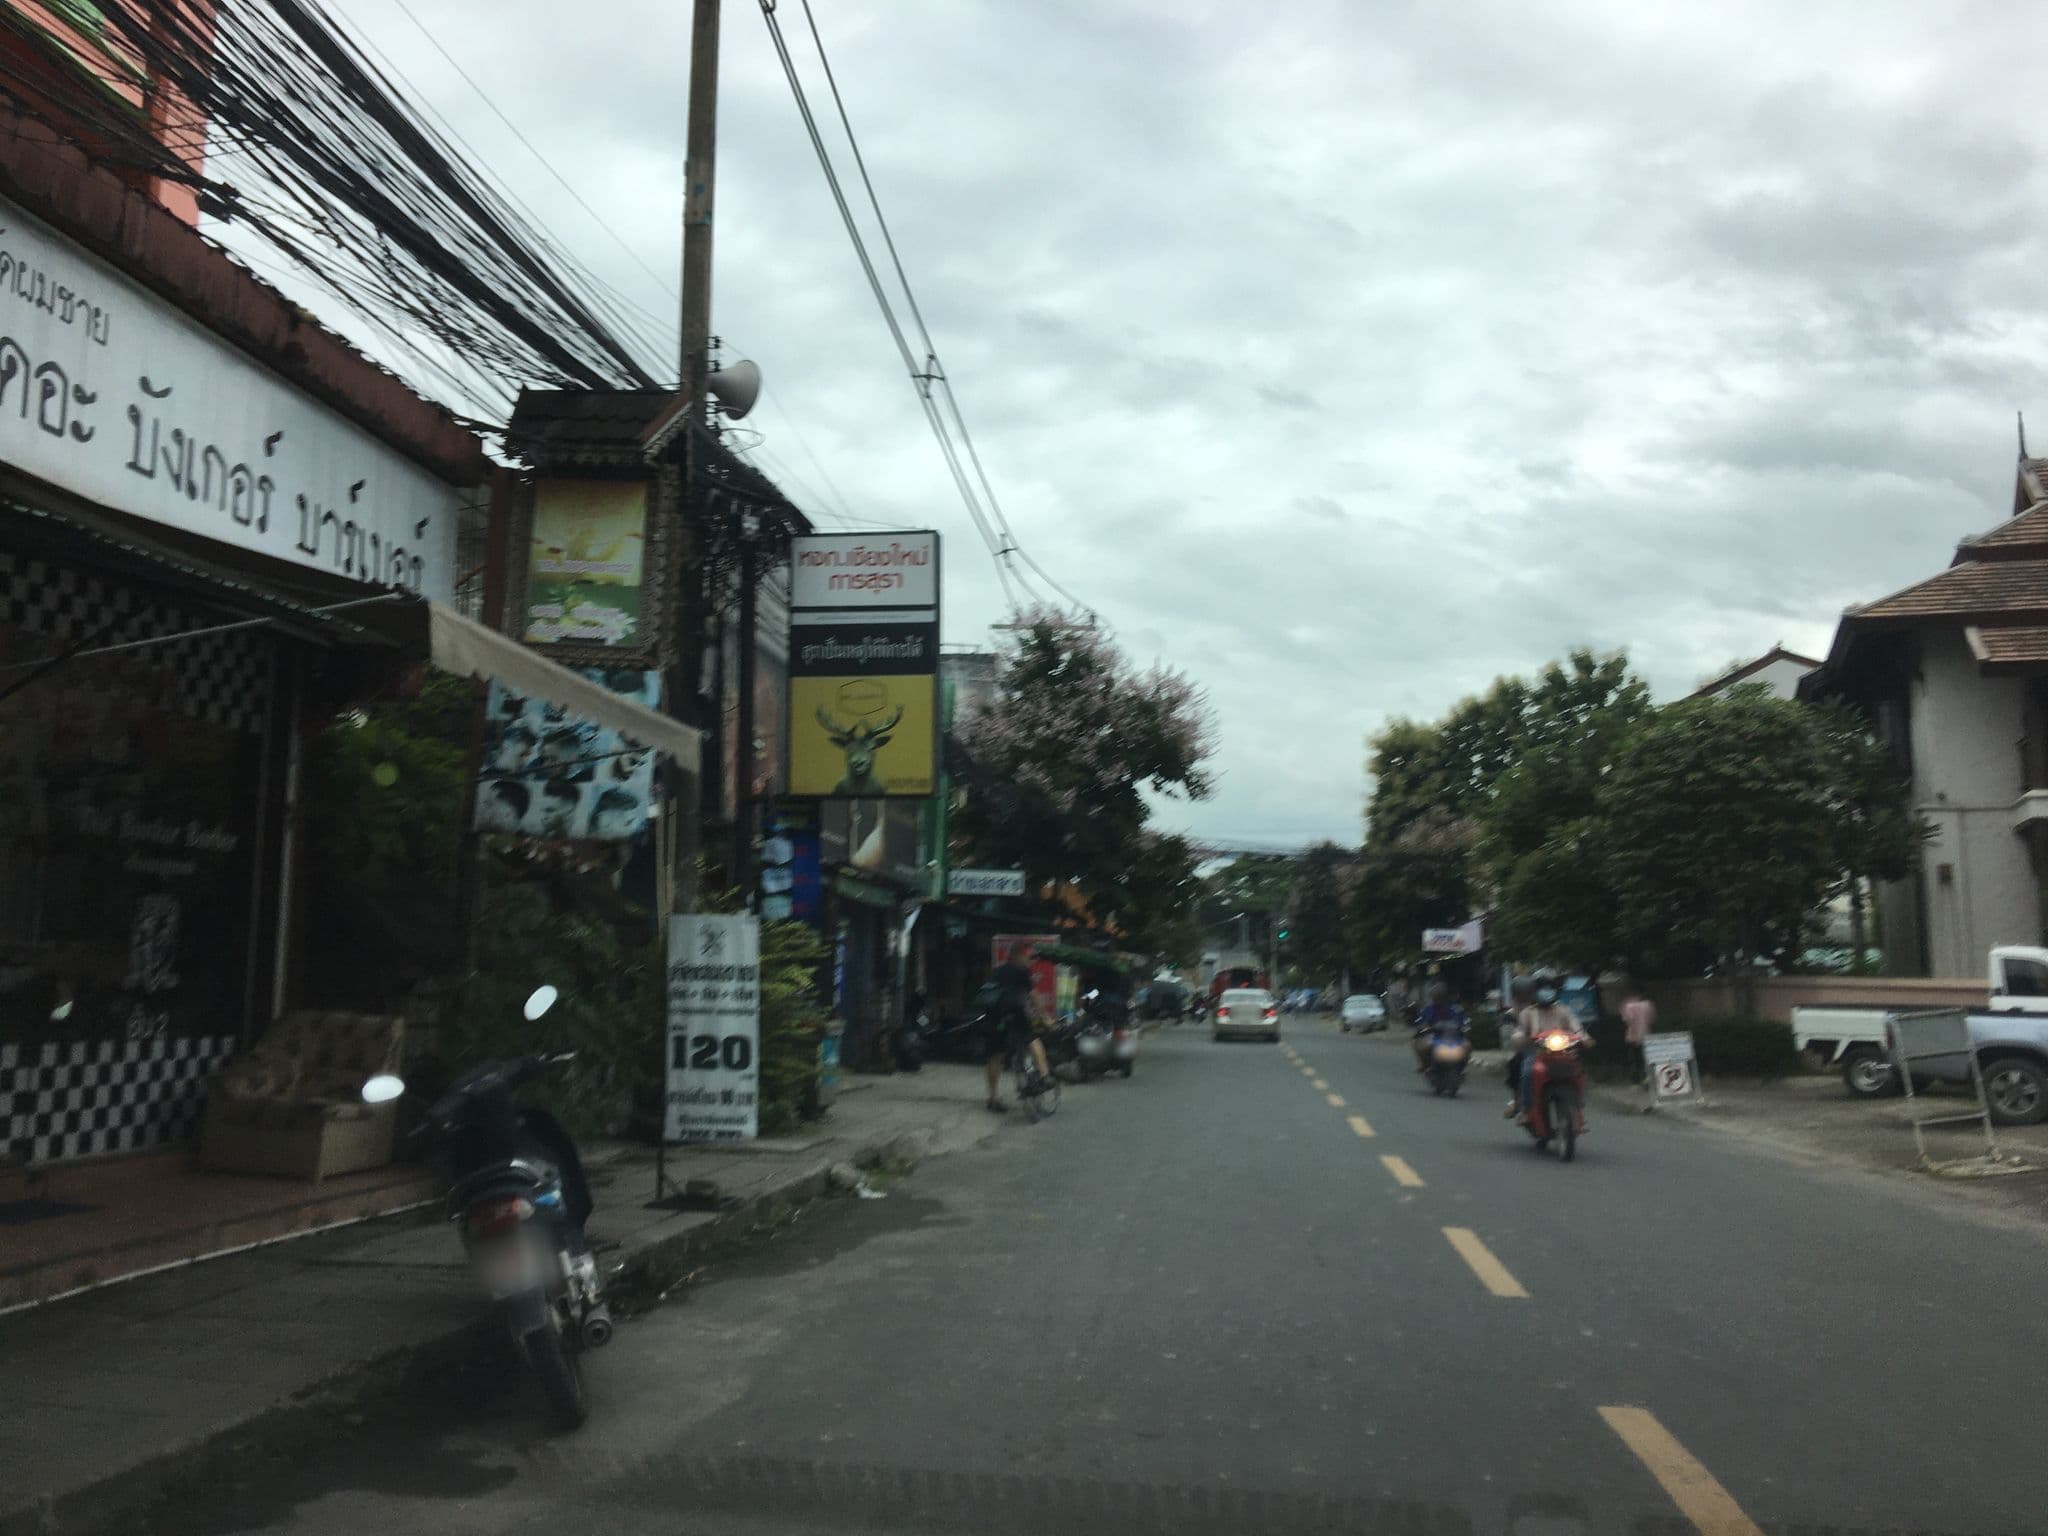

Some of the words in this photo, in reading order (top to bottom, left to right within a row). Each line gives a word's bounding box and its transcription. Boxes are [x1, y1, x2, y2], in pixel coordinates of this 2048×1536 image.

[126, 376, 285, 535] บังเกอร์
[828, 572, 904, 595] การสุรา
[672, 1034, 752, 1071] 120
